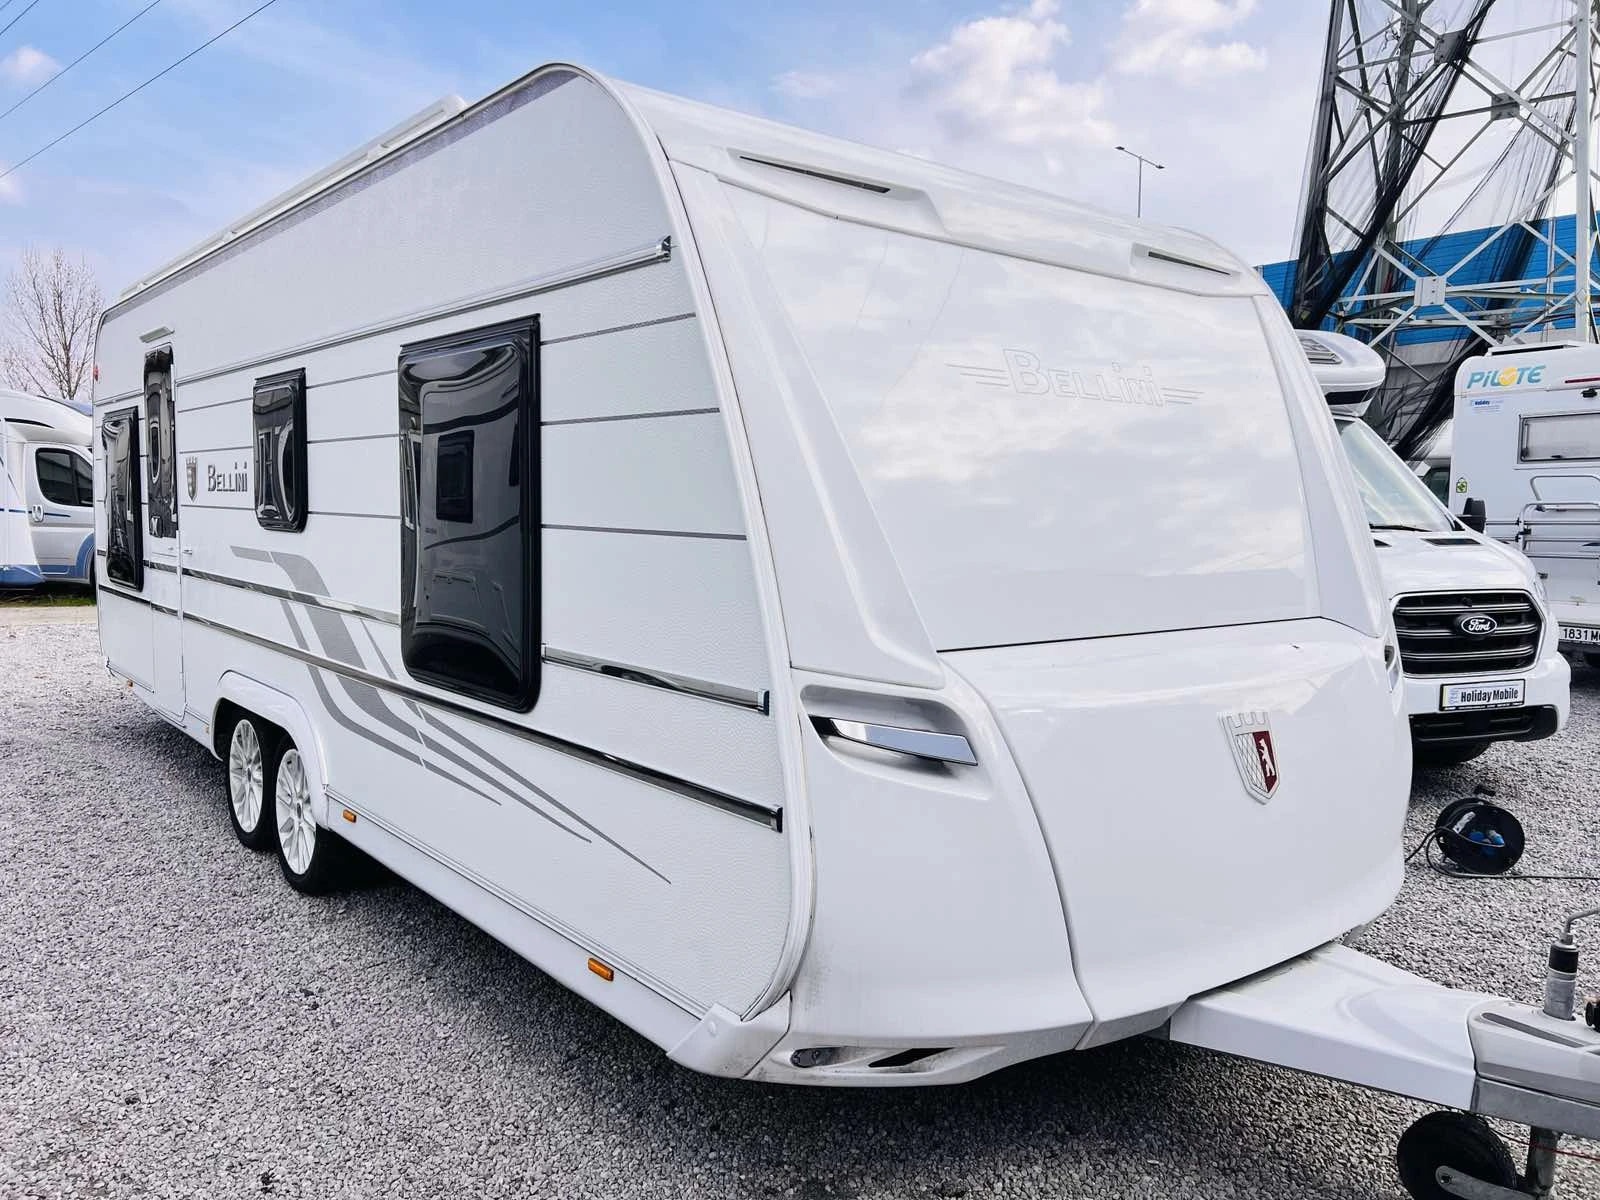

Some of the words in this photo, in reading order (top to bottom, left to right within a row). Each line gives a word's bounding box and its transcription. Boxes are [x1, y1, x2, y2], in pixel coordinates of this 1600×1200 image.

[1468, 618, 1491, 631] Ford
[1563, 628, 1588, 641] 1831
[1590, 630, 1600, 641] M
[1460, 689, 1492, 703] Holiday
[1492, 687, 1519, 701] Mobile
